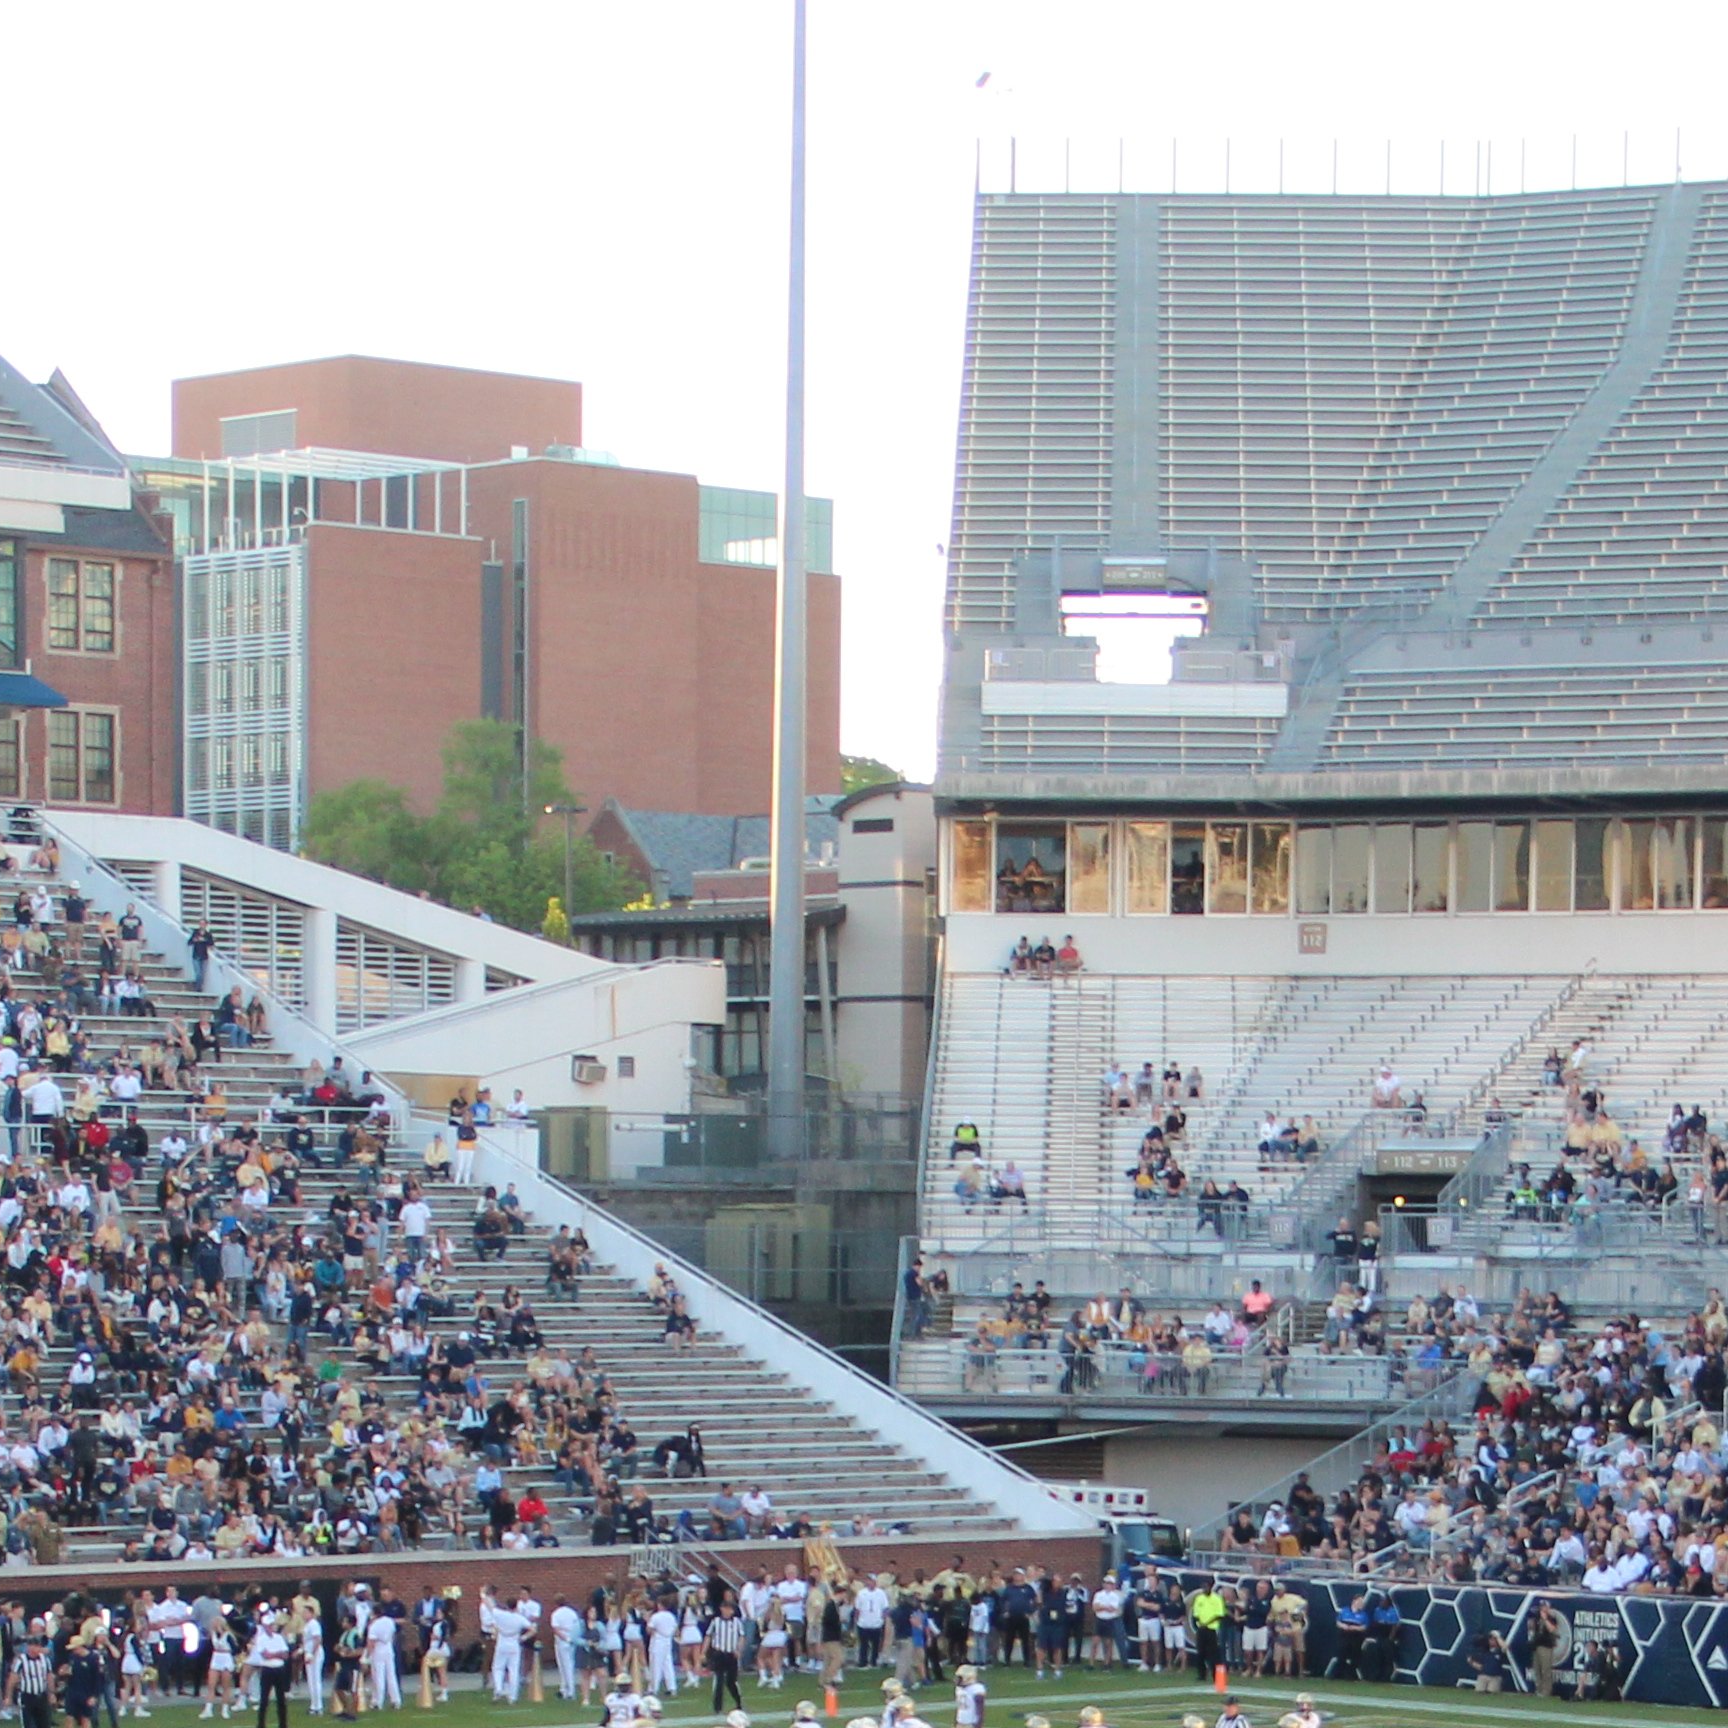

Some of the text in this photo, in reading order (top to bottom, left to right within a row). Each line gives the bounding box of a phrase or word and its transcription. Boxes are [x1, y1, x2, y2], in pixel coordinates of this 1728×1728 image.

[1394, 1156, 1414, 1169] 112
[1438, 1156, 1457, 1169] 113
[1574, 1611, 1619, 1628] ATHLETICS
